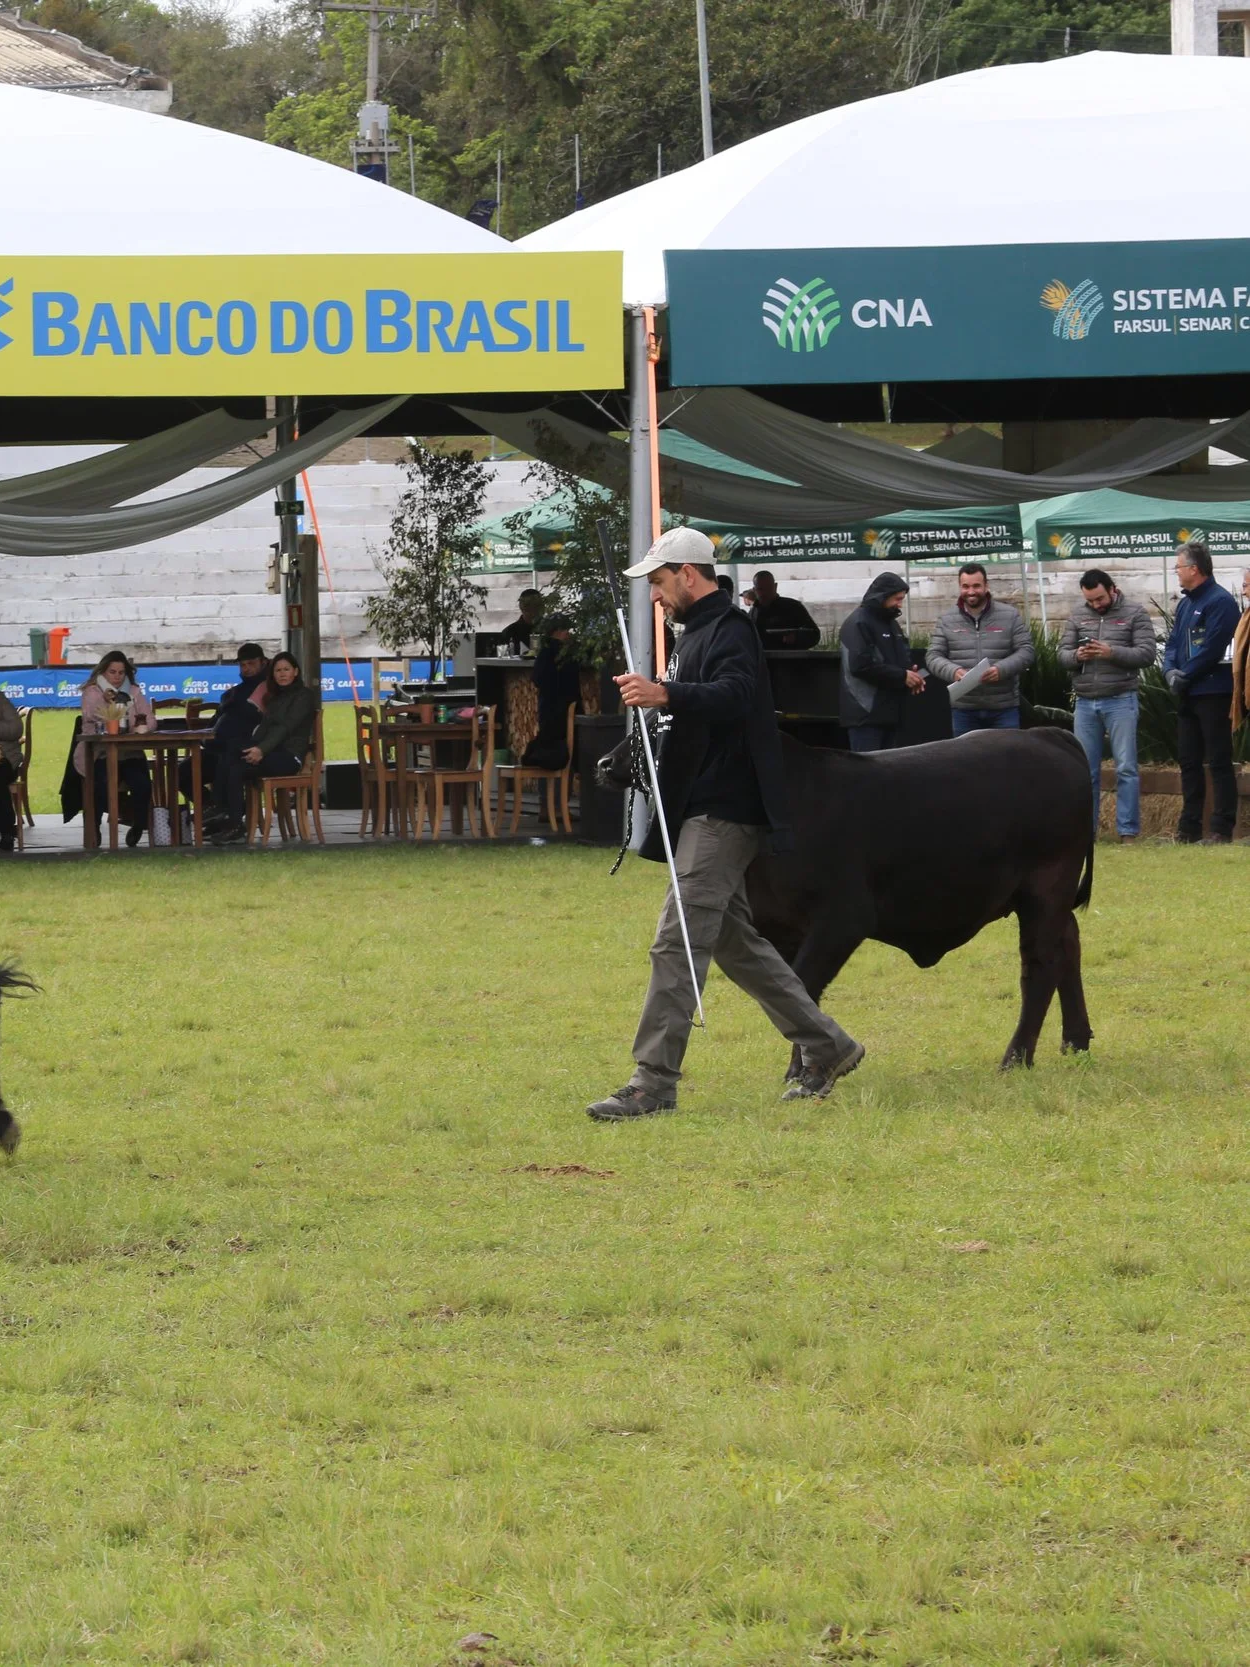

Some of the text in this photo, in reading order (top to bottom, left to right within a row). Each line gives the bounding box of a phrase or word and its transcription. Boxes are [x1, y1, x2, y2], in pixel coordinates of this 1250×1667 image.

[1112, 287, 1228, 312] SISTEMA
[851, 298, 933, 329] CNA
[32, 289, 585, 357] BANCO DO BRASIL
[1113, 319, 1172, 334] FARSUL
[1179, 317, 1232, 332] SENAR
[744, 532, 855, 547] SISTEMA FARSUL
[900, 525, 1011, 543] SISTEMA FARSUL
[1079, 533, 1173, 547] SISTEMA FARSUL
[1208, 531, 1250, 542] SISTEM
[743, 547, 856, 558] FARSUL SENAR CASA RURAL
[900, 545, 930, 554] FARSUL
[933, 543, 961, 551] SENAR
[963, 541, 985, 550] CASA
[985, 539, 1012, 548] RURAL
[1133, 546, 1152, 554] CASA
[27, 687, 55, 695] CAIXA
[148, 684, 176, 692] CAIXA
[187, 680, 209, 688] AGRO
